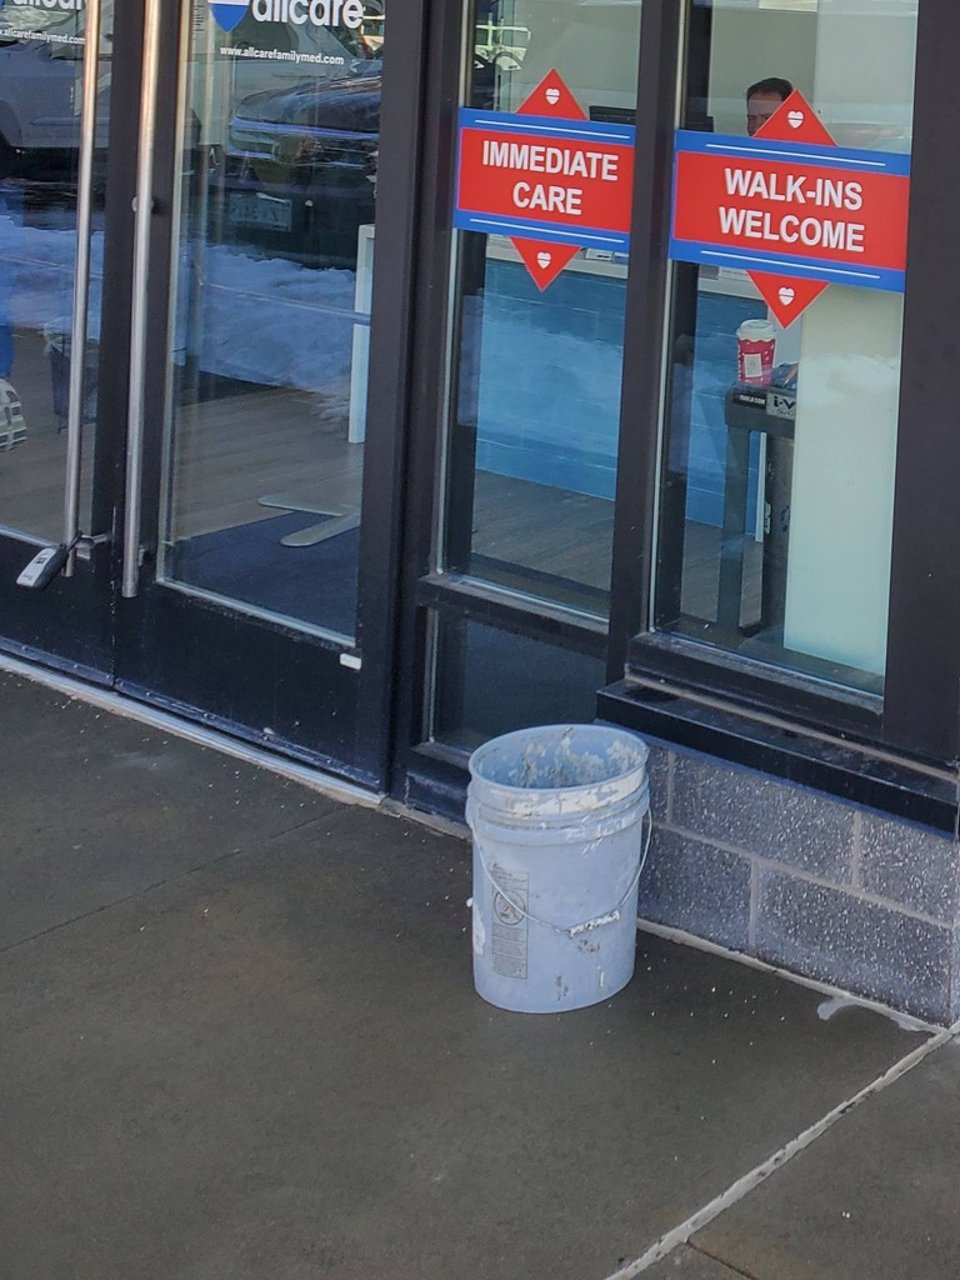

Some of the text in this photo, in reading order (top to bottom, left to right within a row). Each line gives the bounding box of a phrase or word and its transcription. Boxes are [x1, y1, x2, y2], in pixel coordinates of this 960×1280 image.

[219, 46, 345, 65] www.allcarefamilymed.com
[482, 139, 619, 182] IMMEDIATE
[512, 182, 583, 217] CARE
[724, 167, 863, 212] WALK-INS
[718, 206, 866, 254] WELCOME
